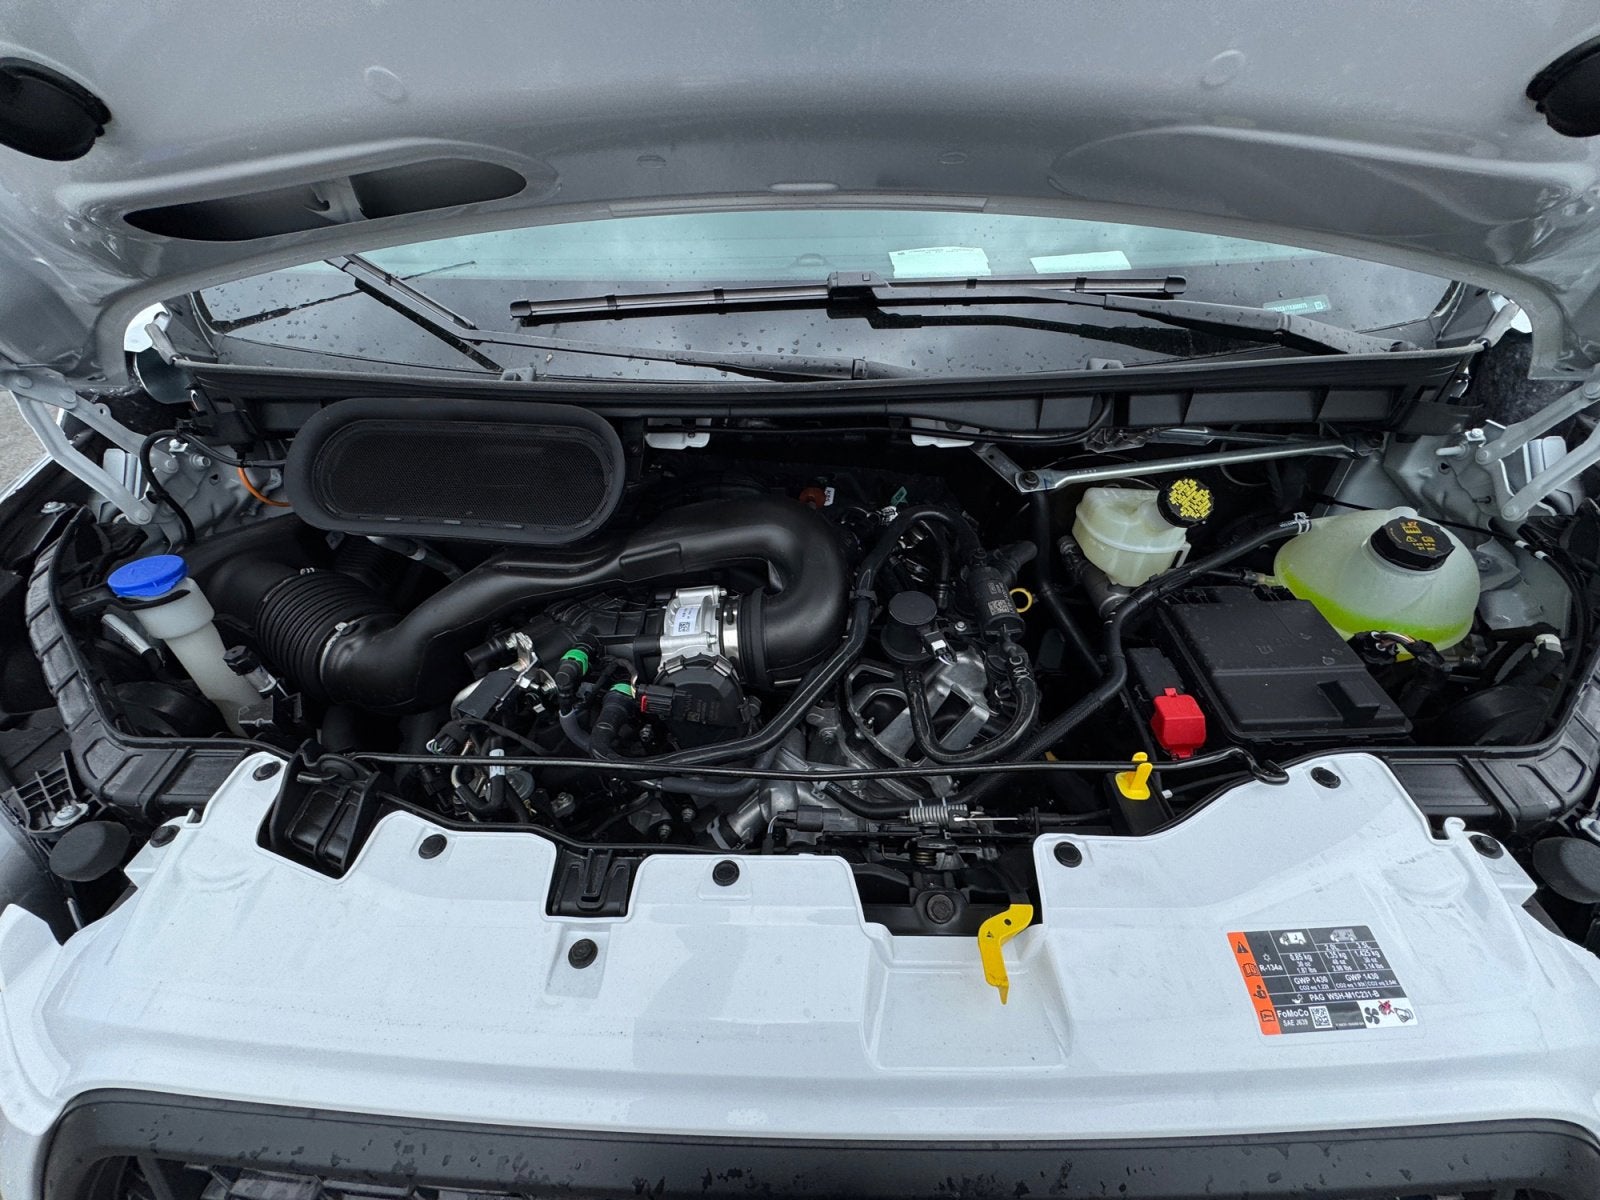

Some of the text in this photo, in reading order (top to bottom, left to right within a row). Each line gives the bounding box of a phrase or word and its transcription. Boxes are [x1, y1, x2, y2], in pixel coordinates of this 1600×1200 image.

[1303, 952, 1313, 962] kg
[1338, 950, 1348, 960] kg
[1370, 950, 1380, 958] kg
[1258, 964, 1284, 972] R-134a
[1293, 976, 1329, 985] GWP 1430
[1308, 990, 1380, 1002] PAG WSH-M1C231-B
[1277, 1009, 1309, 1018] FoMoCo
